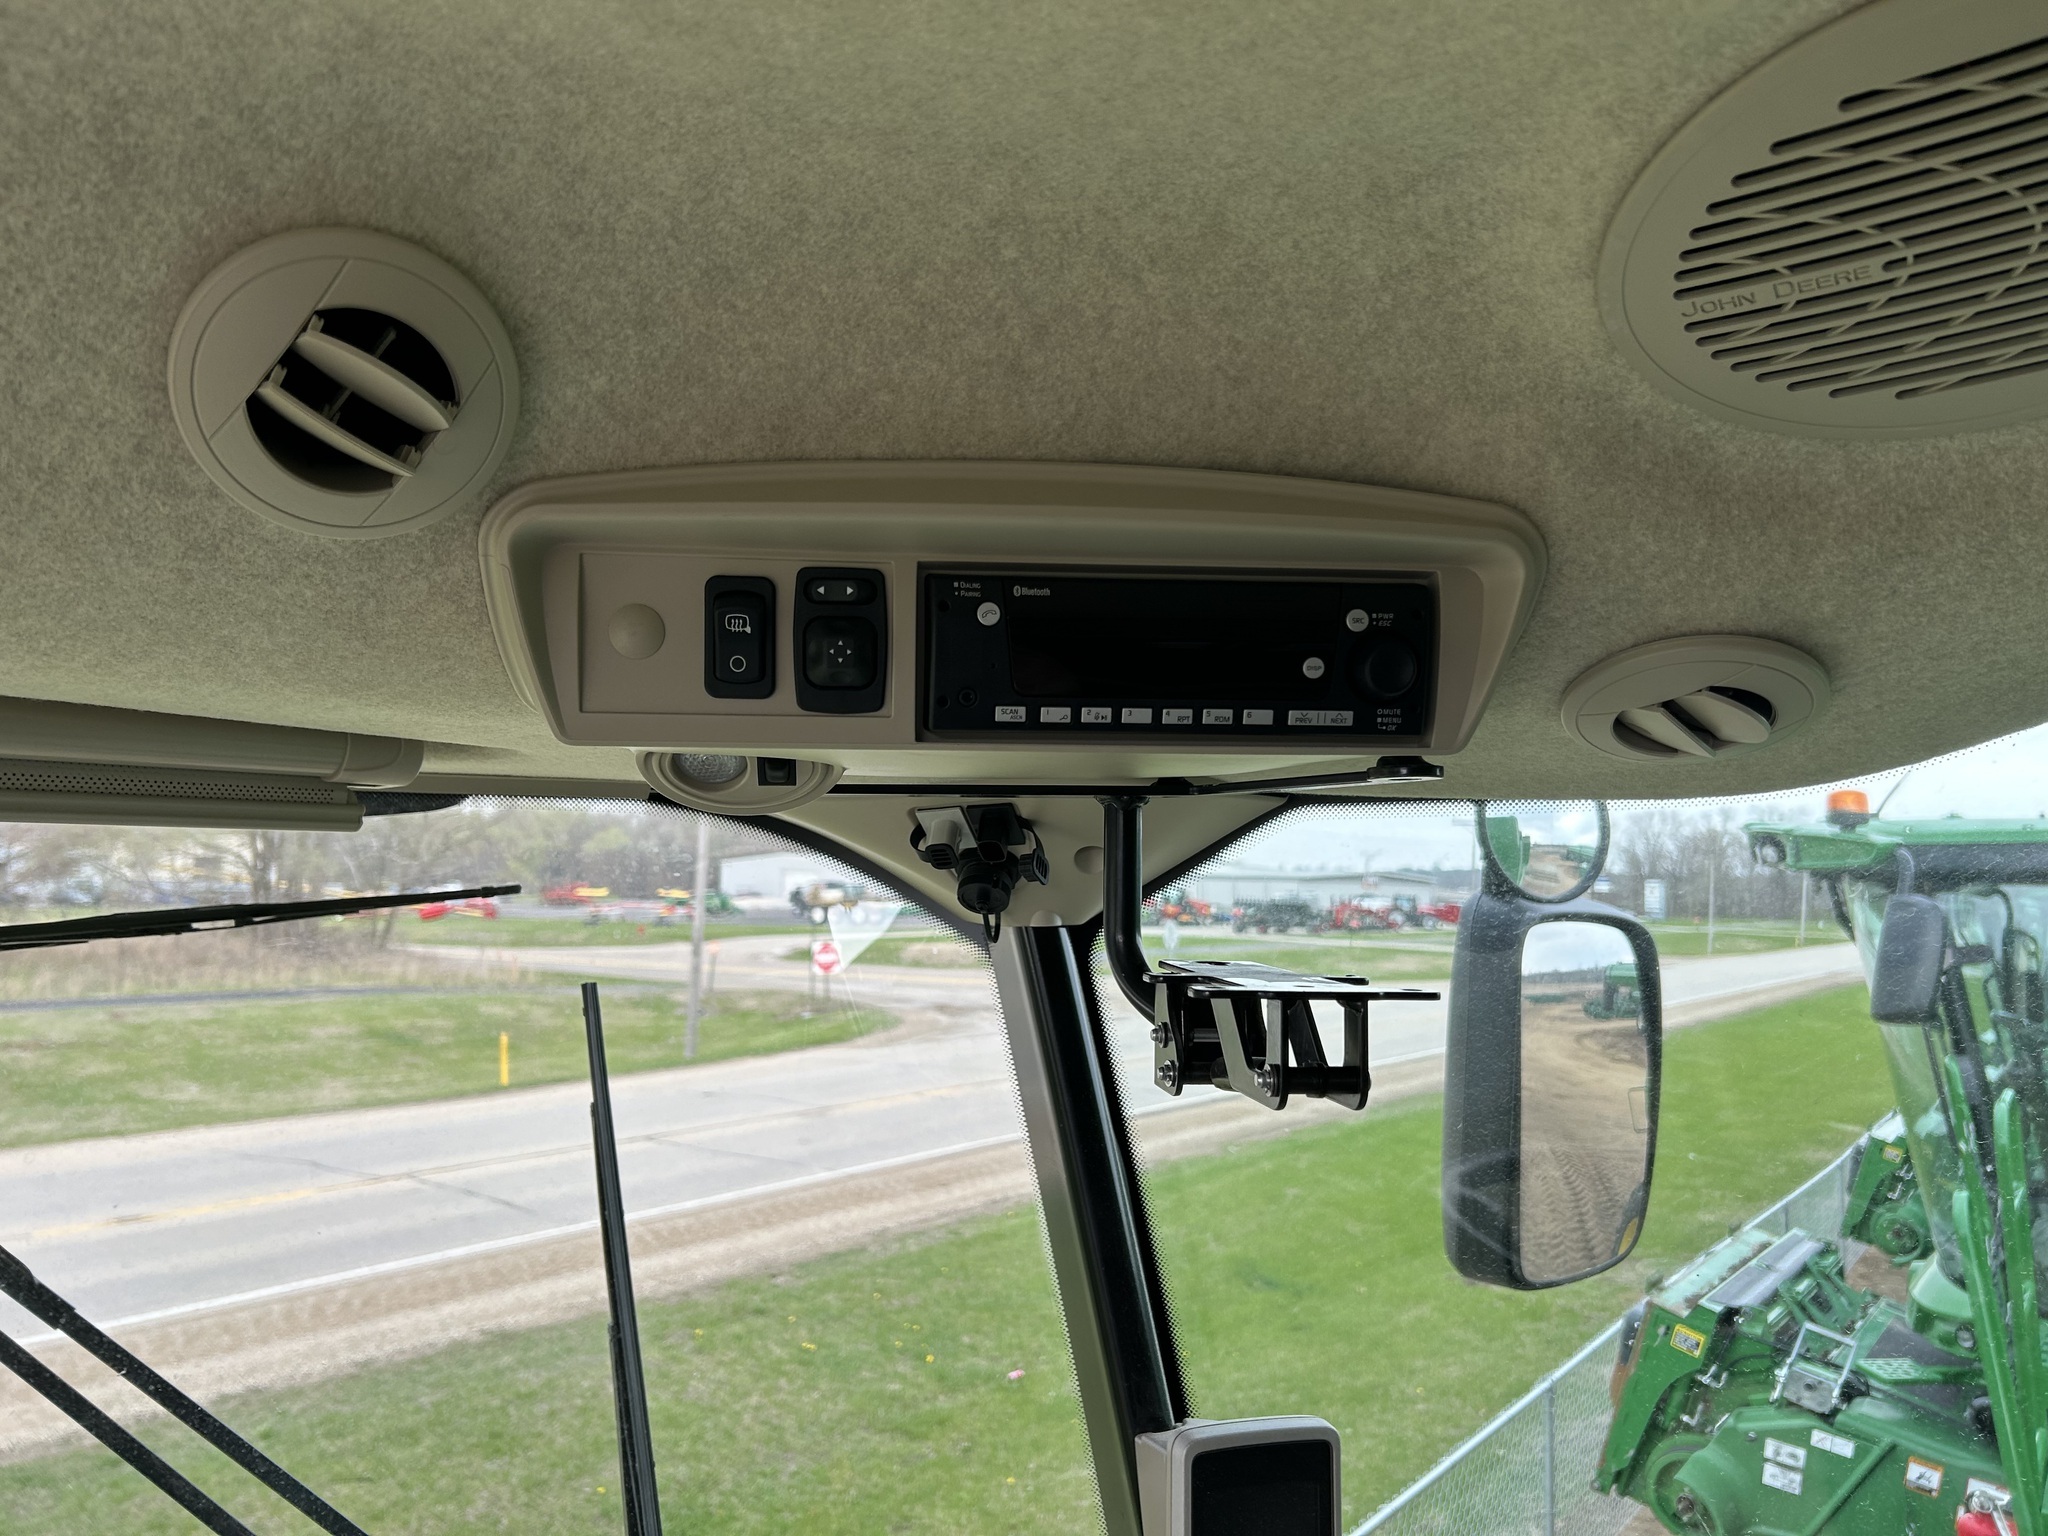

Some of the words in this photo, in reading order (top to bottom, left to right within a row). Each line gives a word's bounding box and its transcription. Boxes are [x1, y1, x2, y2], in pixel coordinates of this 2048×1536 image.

[1681, 291, 1756, 318] JOHN
[1772, 264, 1872, 300] DEERE
[960, 590, 982, 598] PAIRING
[1021, 586, 1051, 597] Bluetooth
